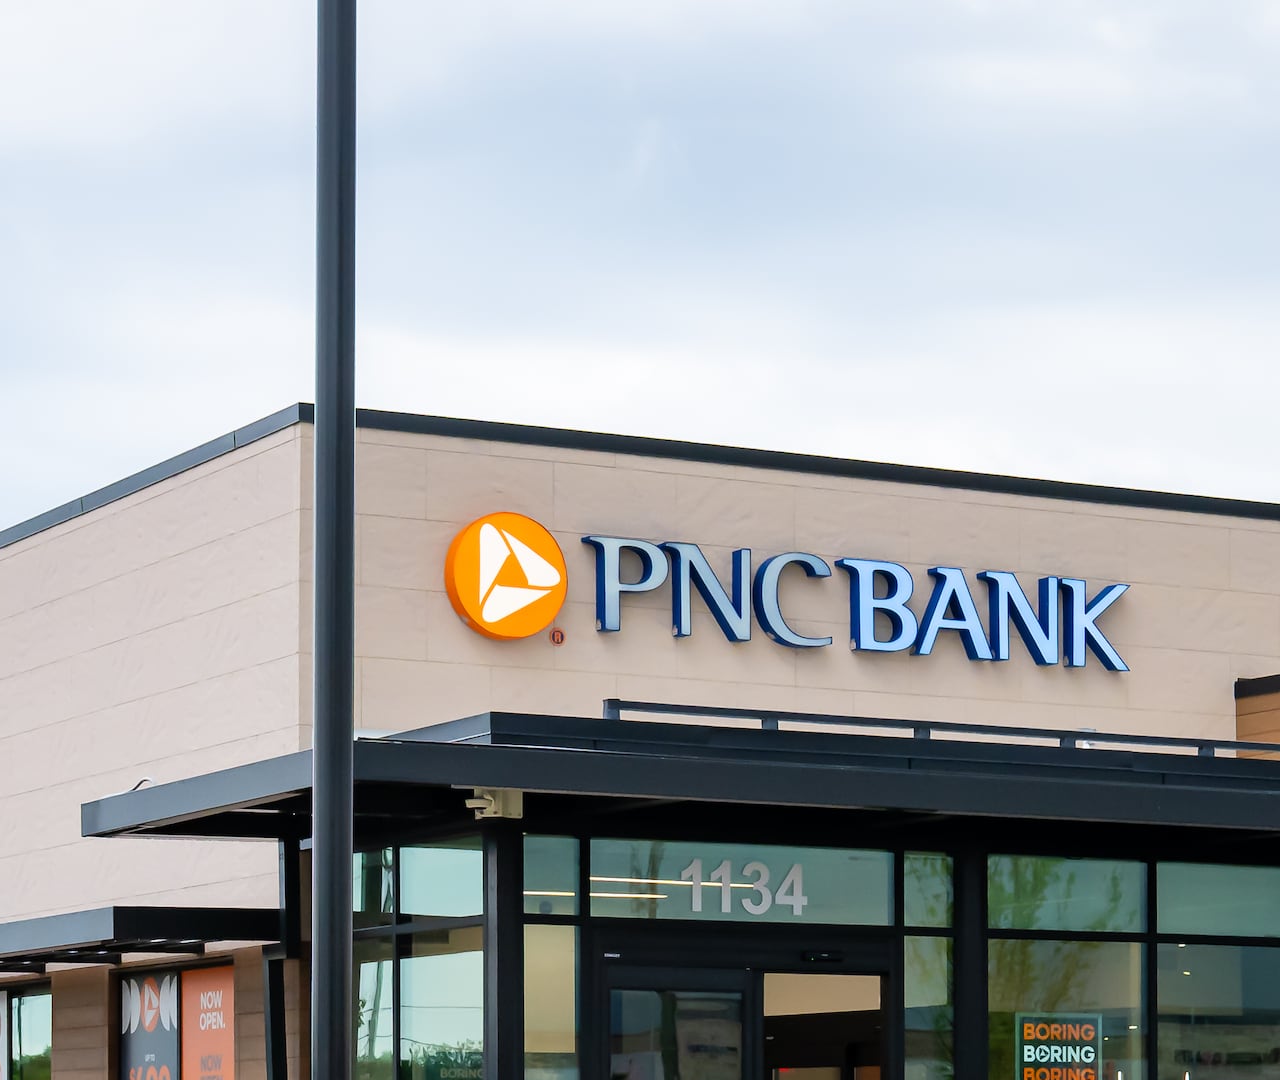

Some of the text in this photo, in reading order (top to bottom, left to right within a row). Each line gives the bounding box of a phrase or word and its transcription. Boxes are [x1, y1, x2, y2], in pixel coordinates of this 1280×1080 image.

[581, 535, 1131, 672] PNC BANK
[679, 858, 808, 917] 1134
[200, 989, 223, 1010] NOW
[199, 1010, 226, 1031] OPEN.
[1023, 1023, 1095, 1041] BORING
[200, 1055, 223, 1072] NOW
[1023, 1045, 1095, 1063] BORING
